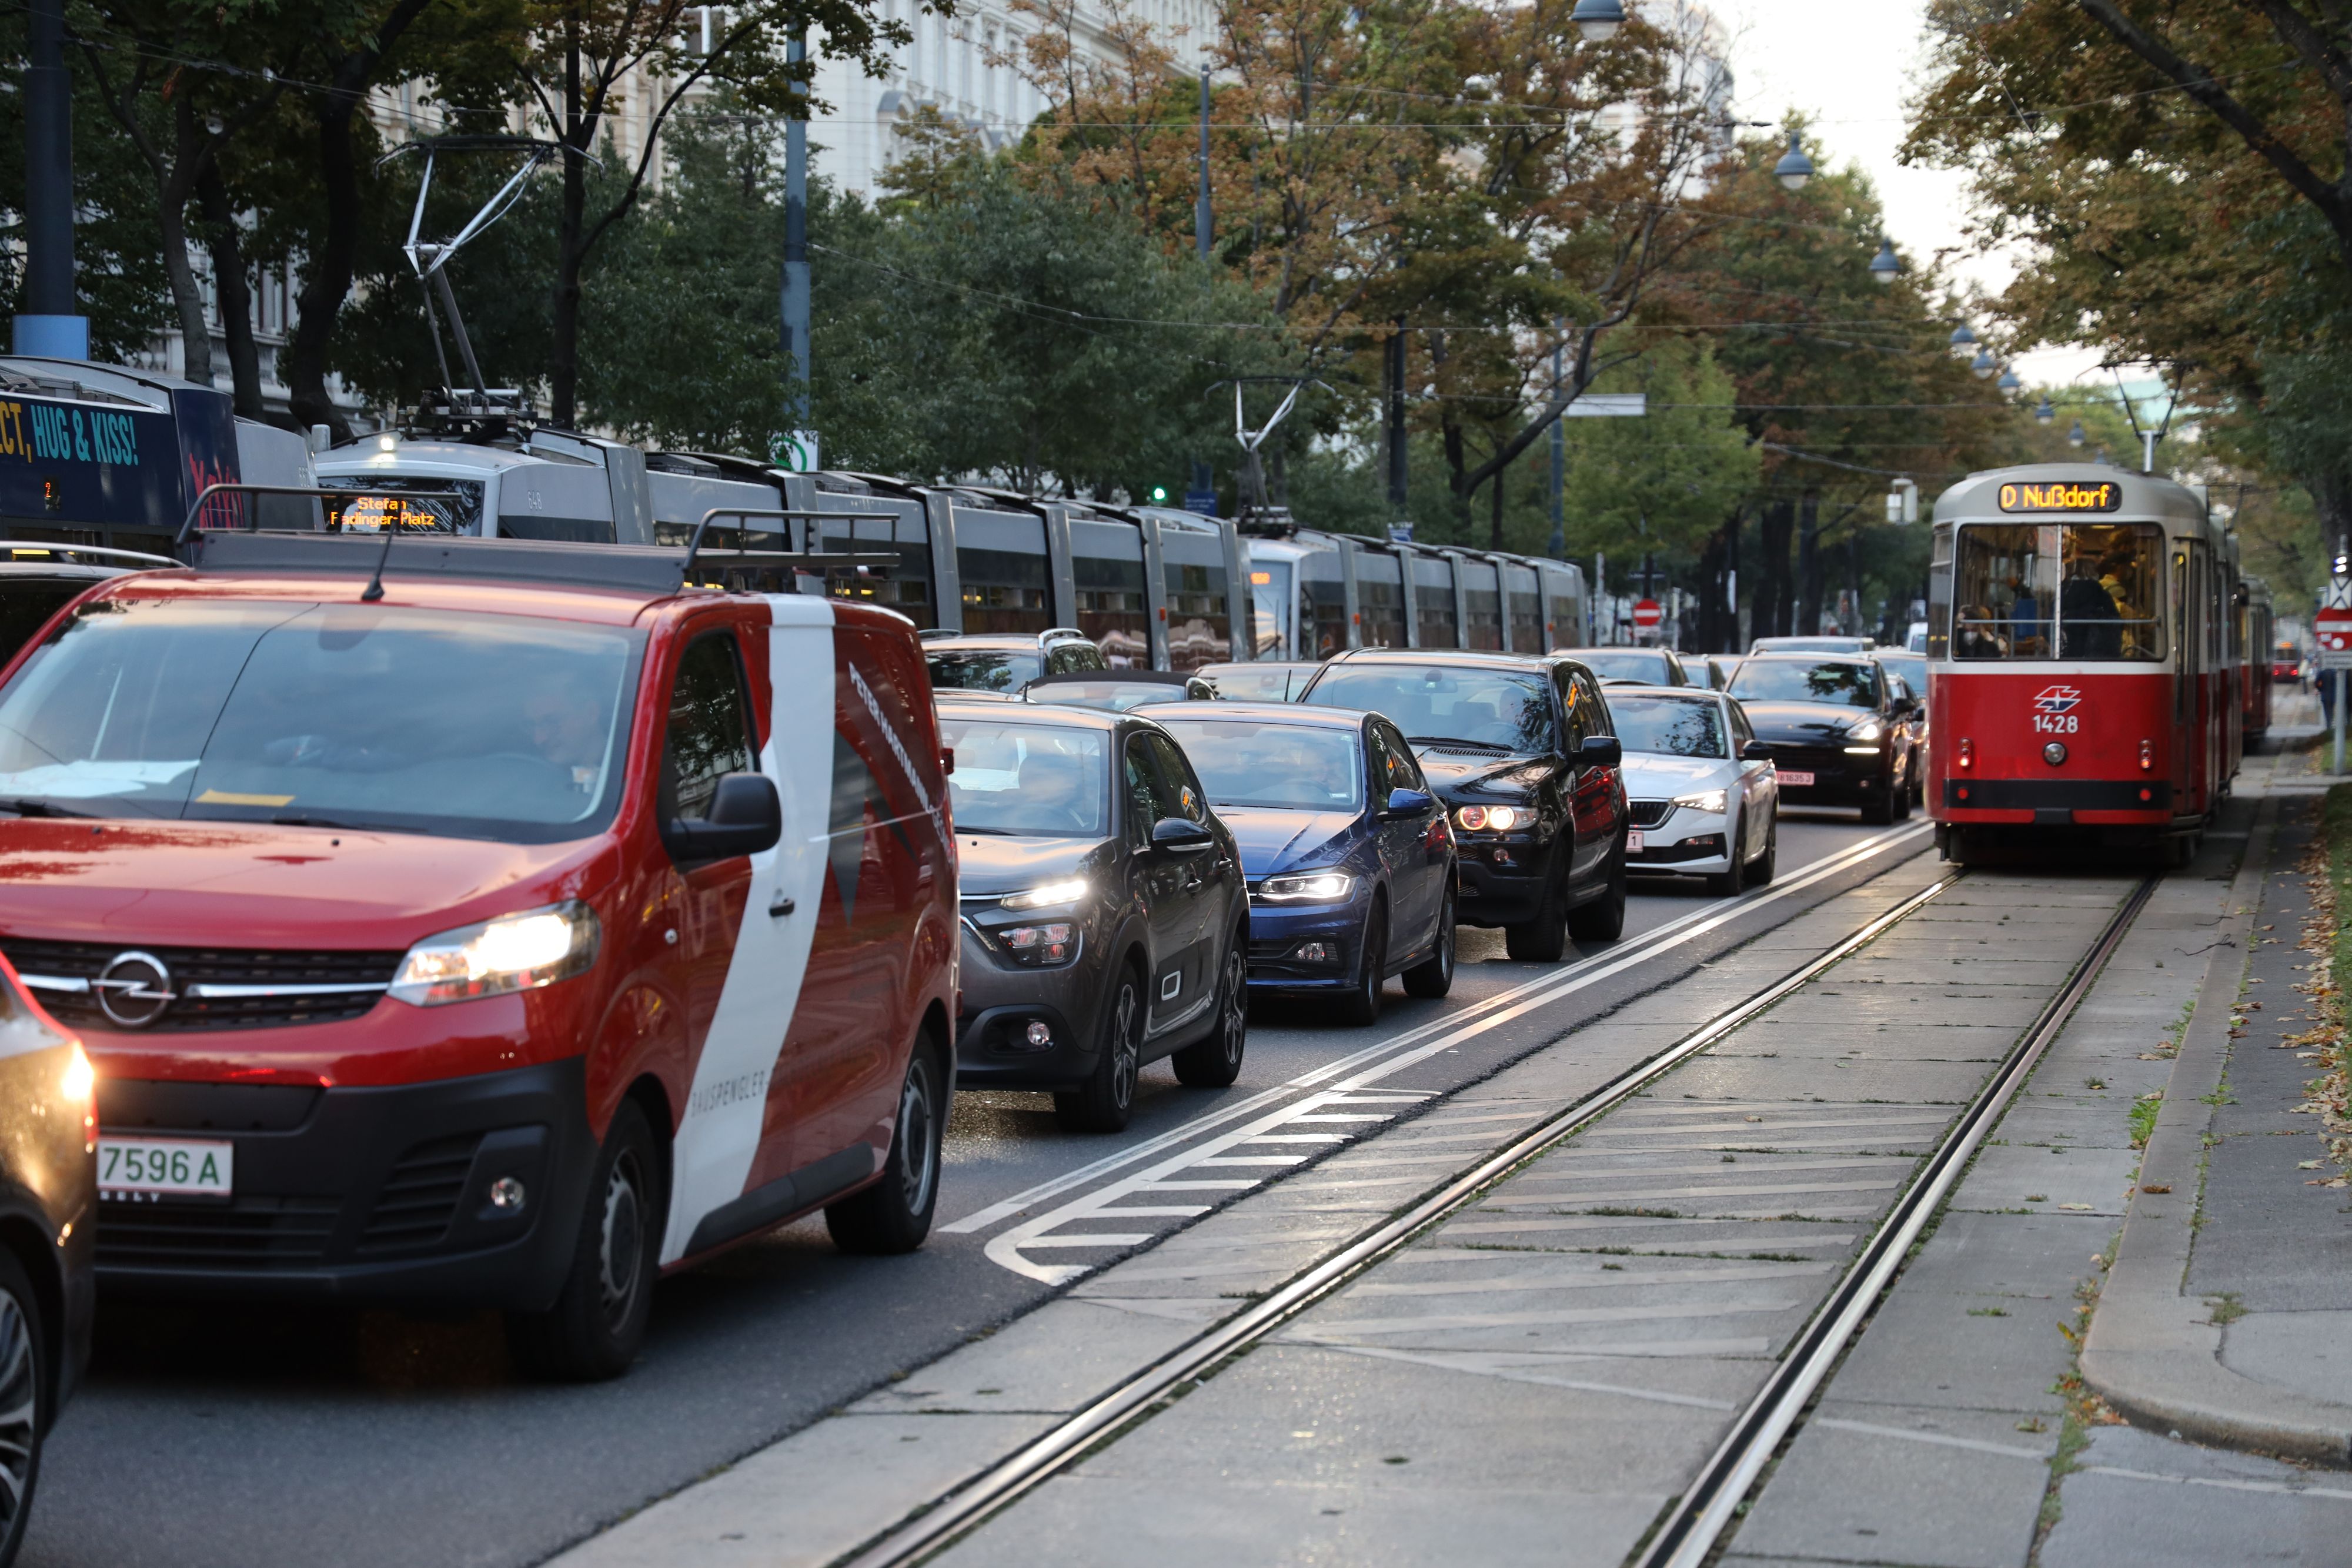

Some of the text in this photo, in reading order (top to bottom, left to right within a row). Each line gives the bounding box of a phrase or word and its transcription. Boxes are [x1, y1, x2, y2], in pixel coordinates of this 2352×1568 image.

[0, 400, 139, 466] CT, HUG & KISS!
[45, 482, 52, 498] 2
[527, 490, 542, 510] 648
[2000, 484, 2110, 509] D Nußdorf
[2032, 714, 2079, 734] 1428
[1631, 835, 1636, 847] 1
